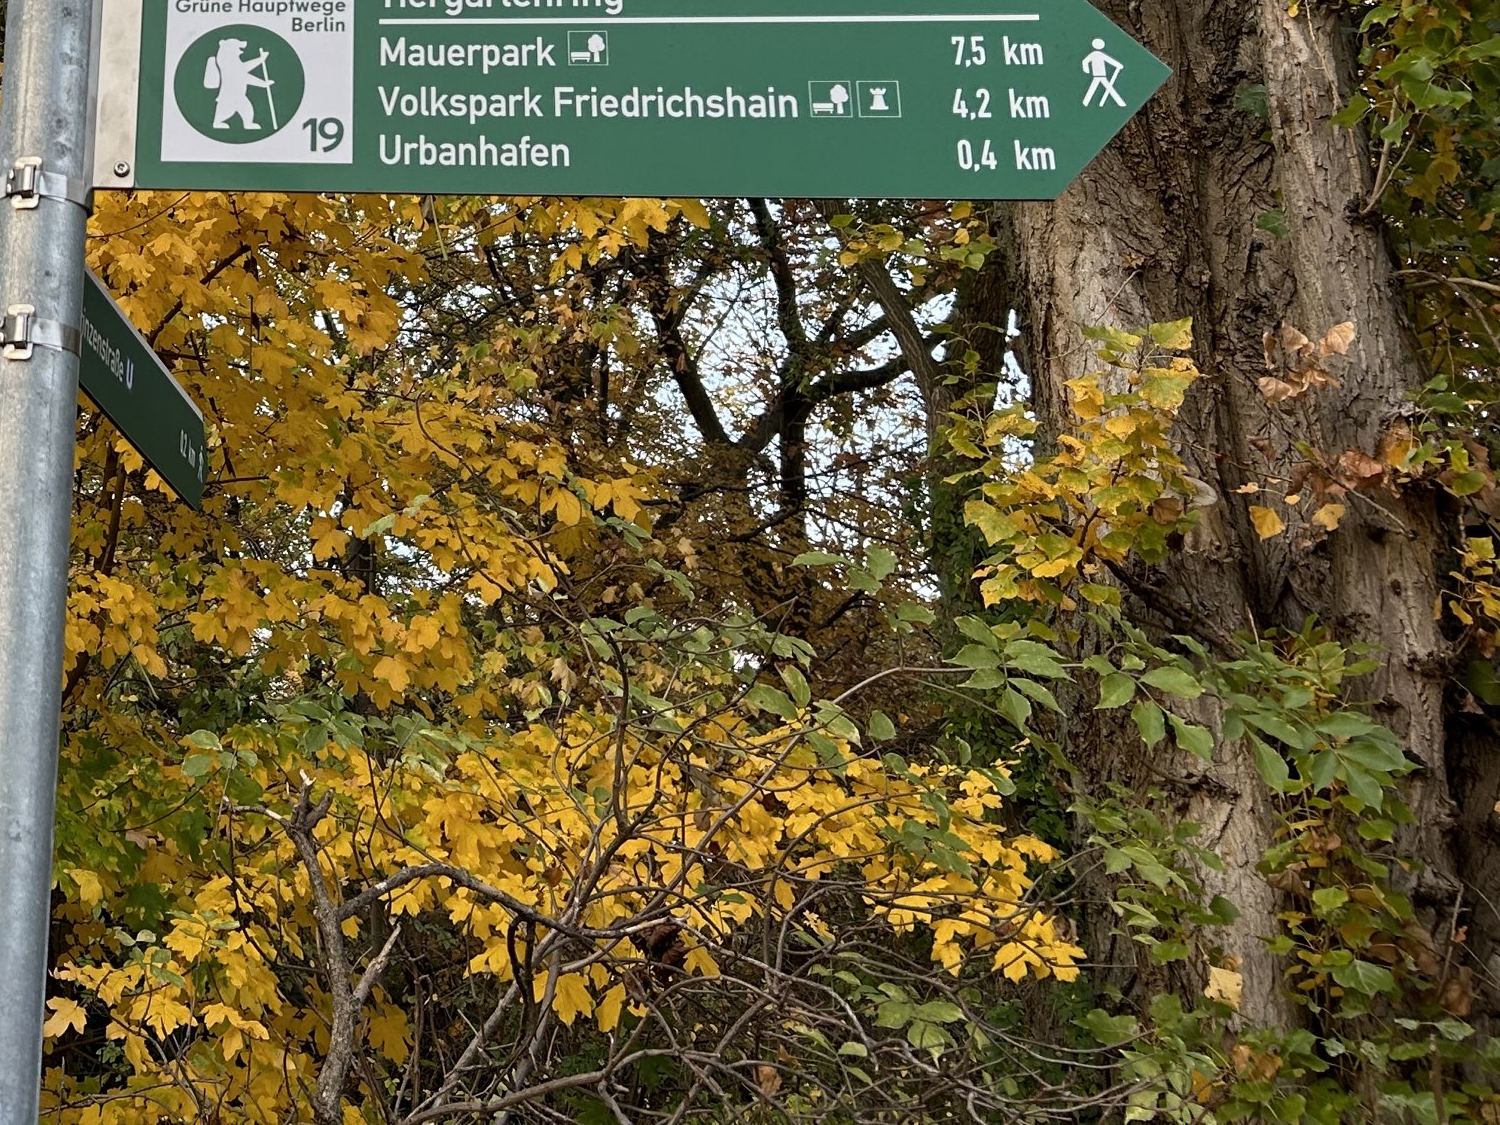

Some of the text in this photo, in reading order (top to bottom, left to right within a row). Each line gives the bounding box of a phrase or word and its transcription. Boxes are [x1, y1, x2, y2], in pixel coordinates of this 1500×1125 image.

[292, 17, 345, 32] Berlin
[381, 37, 555, 74] Mauerpark
[952, 36, 1043, 67] 7,5 km
[378, 86, 798, 124] Volkspark Friedrichshain
[953, 89, 1049, 120] 4,2 km
[303, 118, 344, 152] 19
[380, 135, 569, 166] Urbanhafen
[958, 140, 1055, 171] 0,4 km
